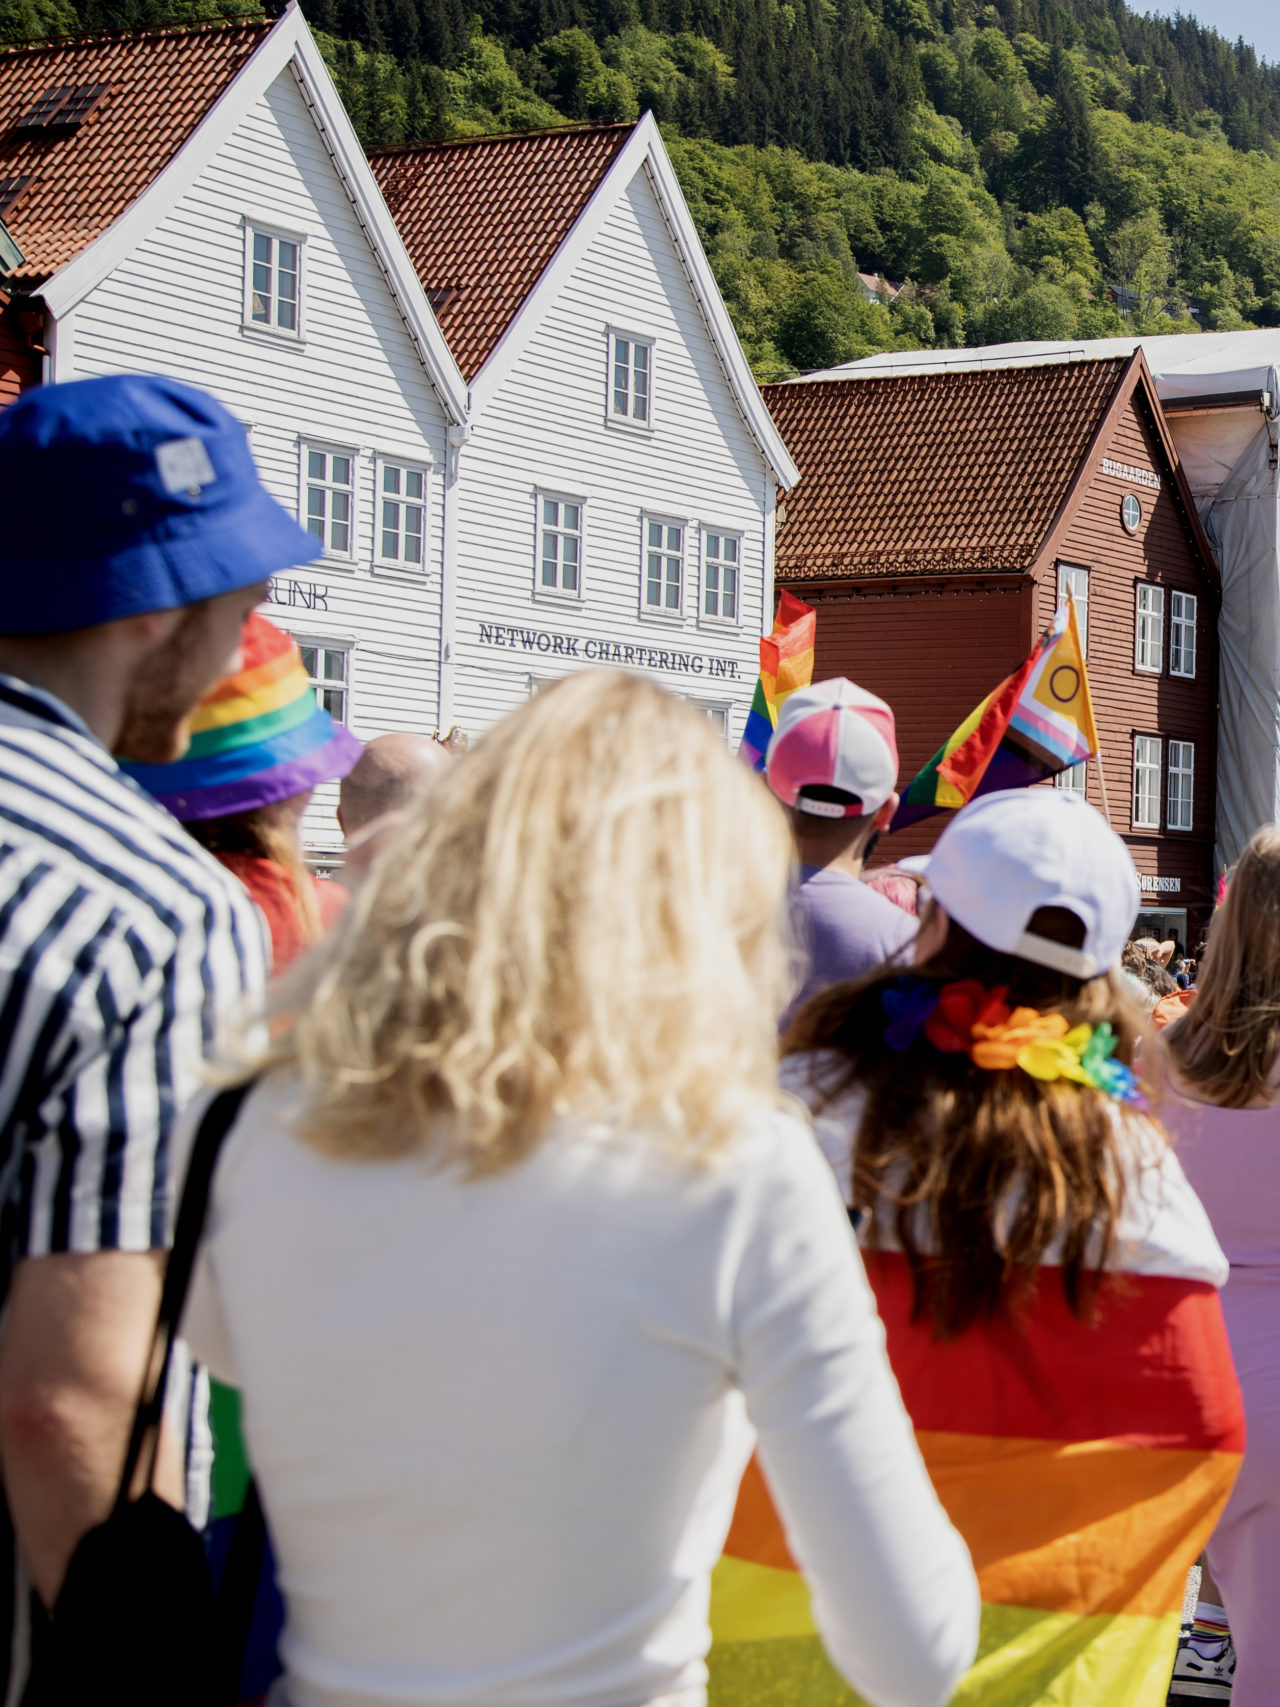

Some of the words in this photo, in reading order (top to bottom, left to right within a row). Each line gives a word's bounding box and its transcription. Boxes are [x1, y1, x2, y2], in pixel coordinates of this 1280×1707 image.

[1102, 457, 1161, 490] BUGAARDEN
[479, 624, 579, 656] NETWORK
[584, 640, 702, 673] CHARTERING
[708, 658, 742, 680] INT.
